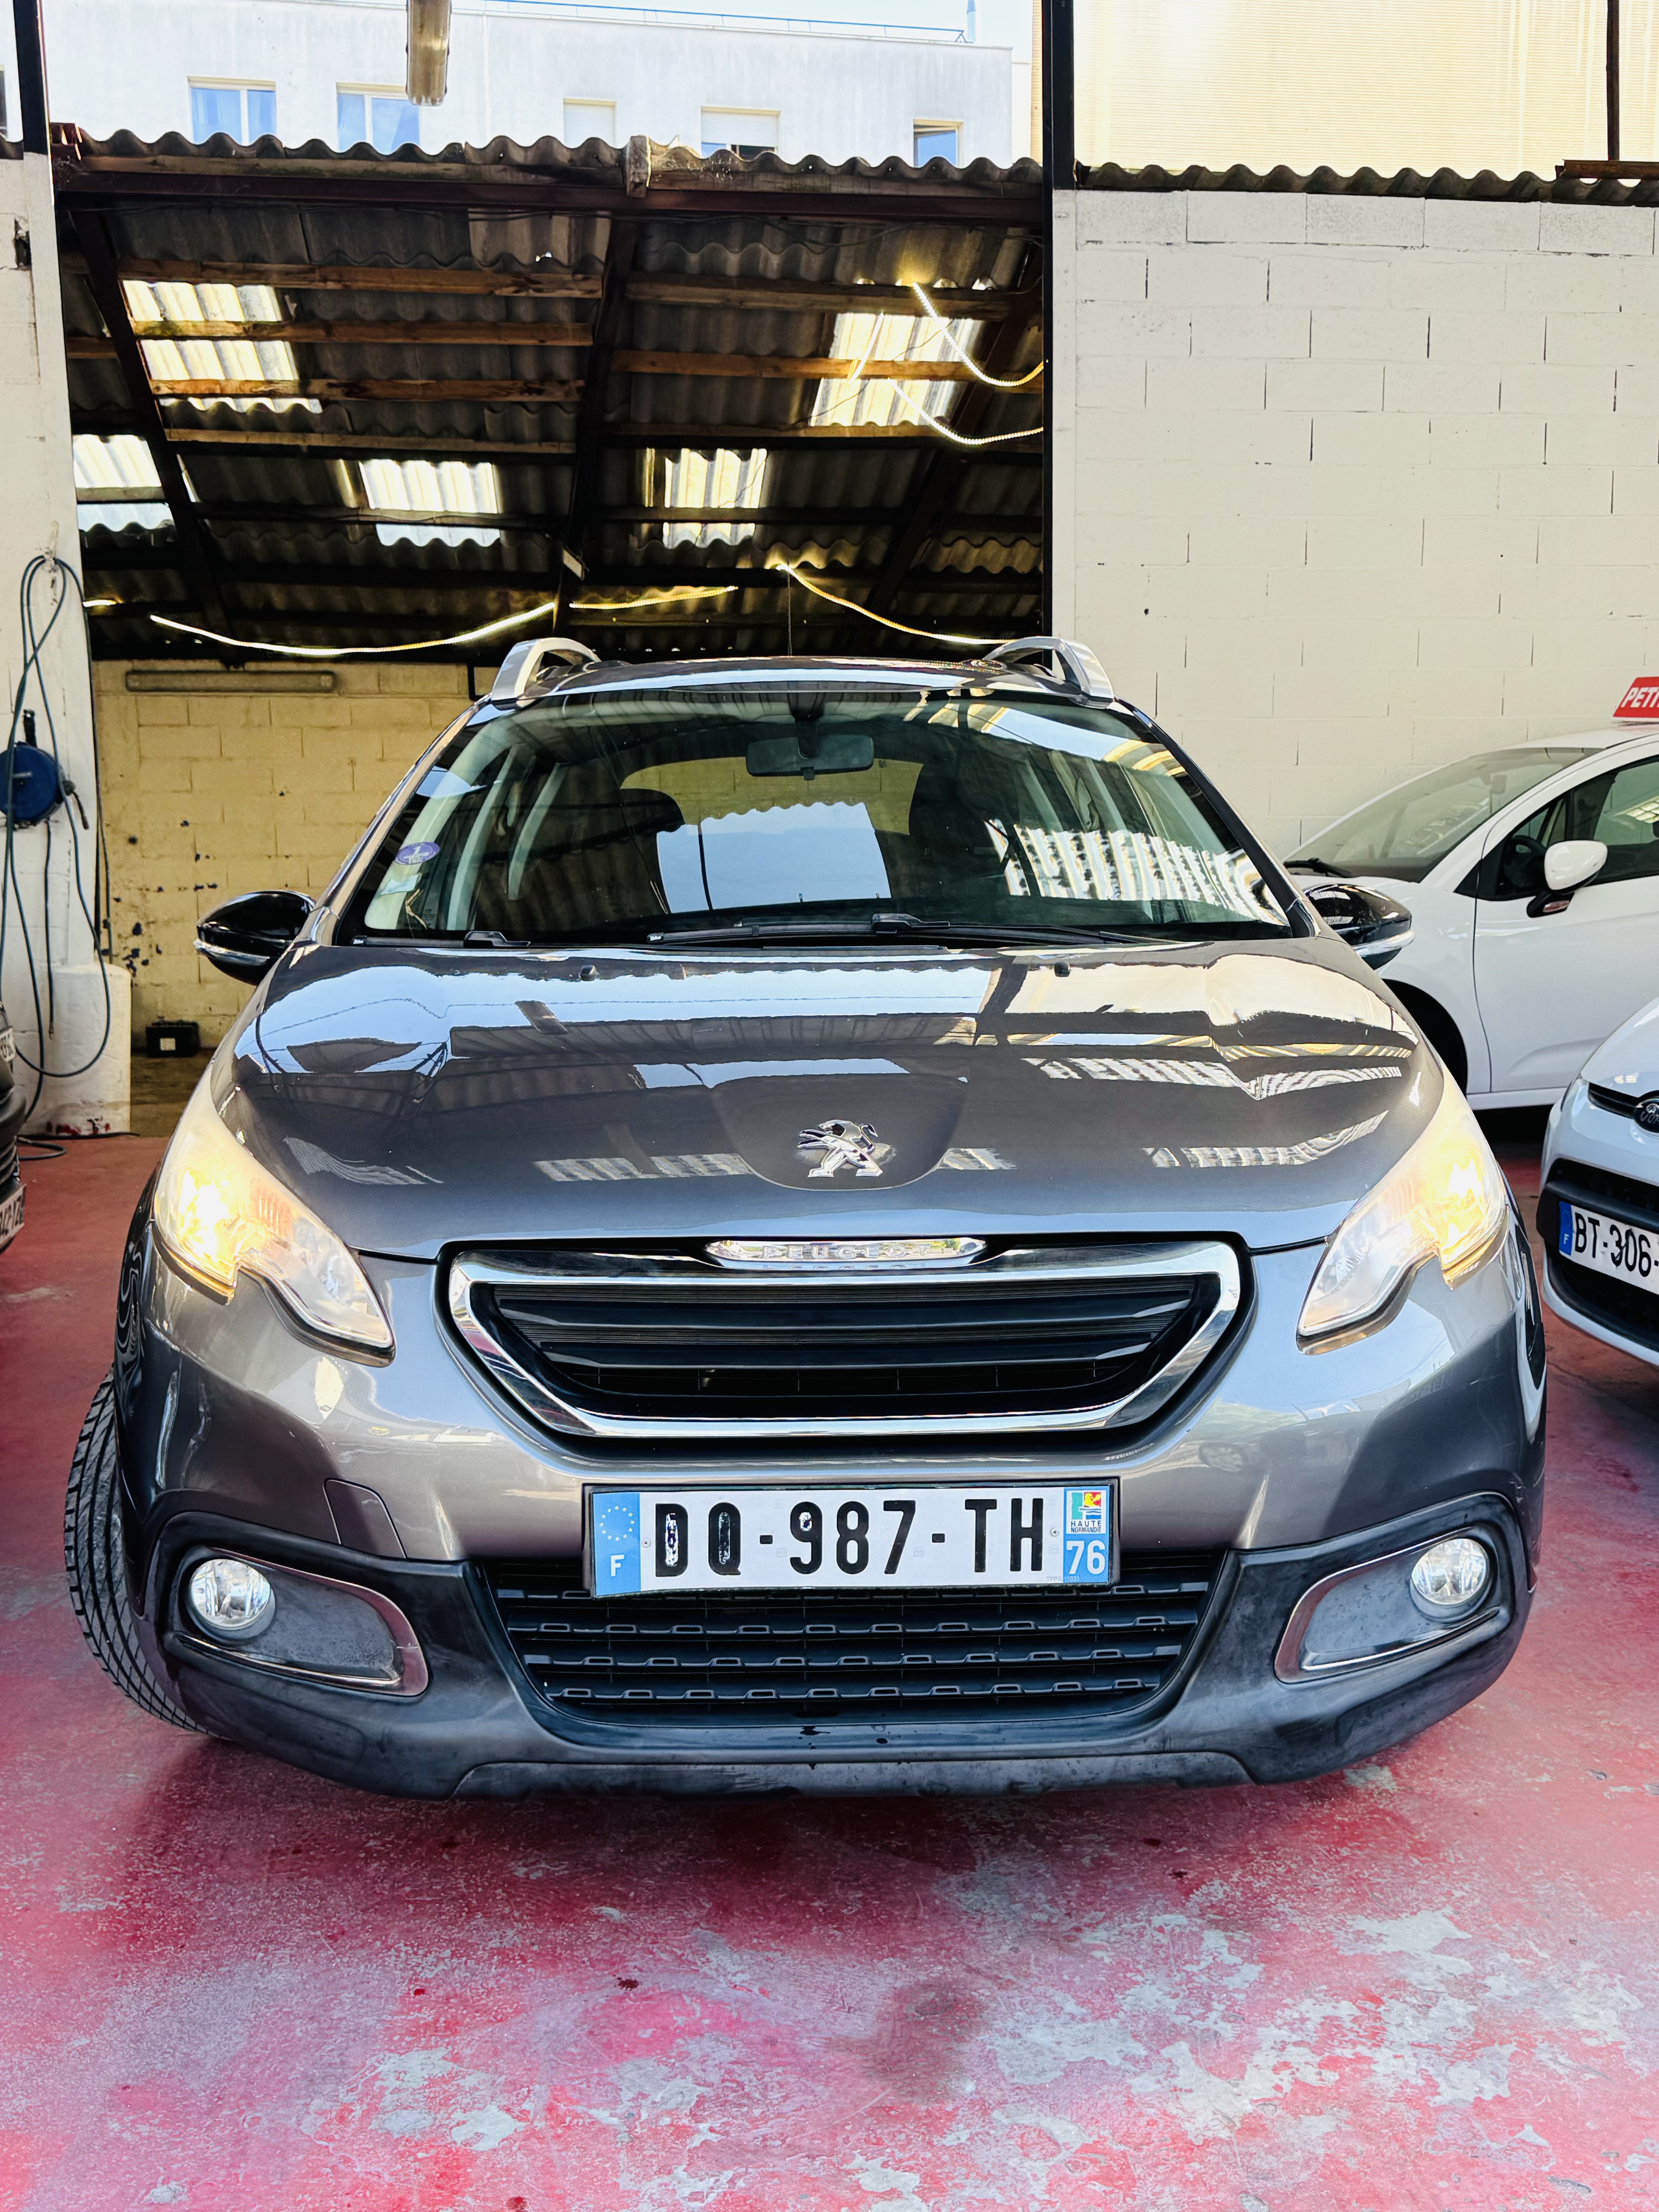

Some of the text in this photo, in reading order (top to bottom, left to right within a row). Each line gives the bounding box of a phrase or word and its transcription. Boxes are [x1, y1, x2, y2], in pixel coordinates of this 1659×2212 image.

[1621, 687, 1659, 708] PETI
[1564, 1233, 1569, 1244] F
[763, 1244, 931, 1259] PEUGEOT
[655, 1498, 1043, 1577] DQ-987-TH
[610, 1554, 625, 1577] F
[1066, 1540, 1106, 1575] 76
